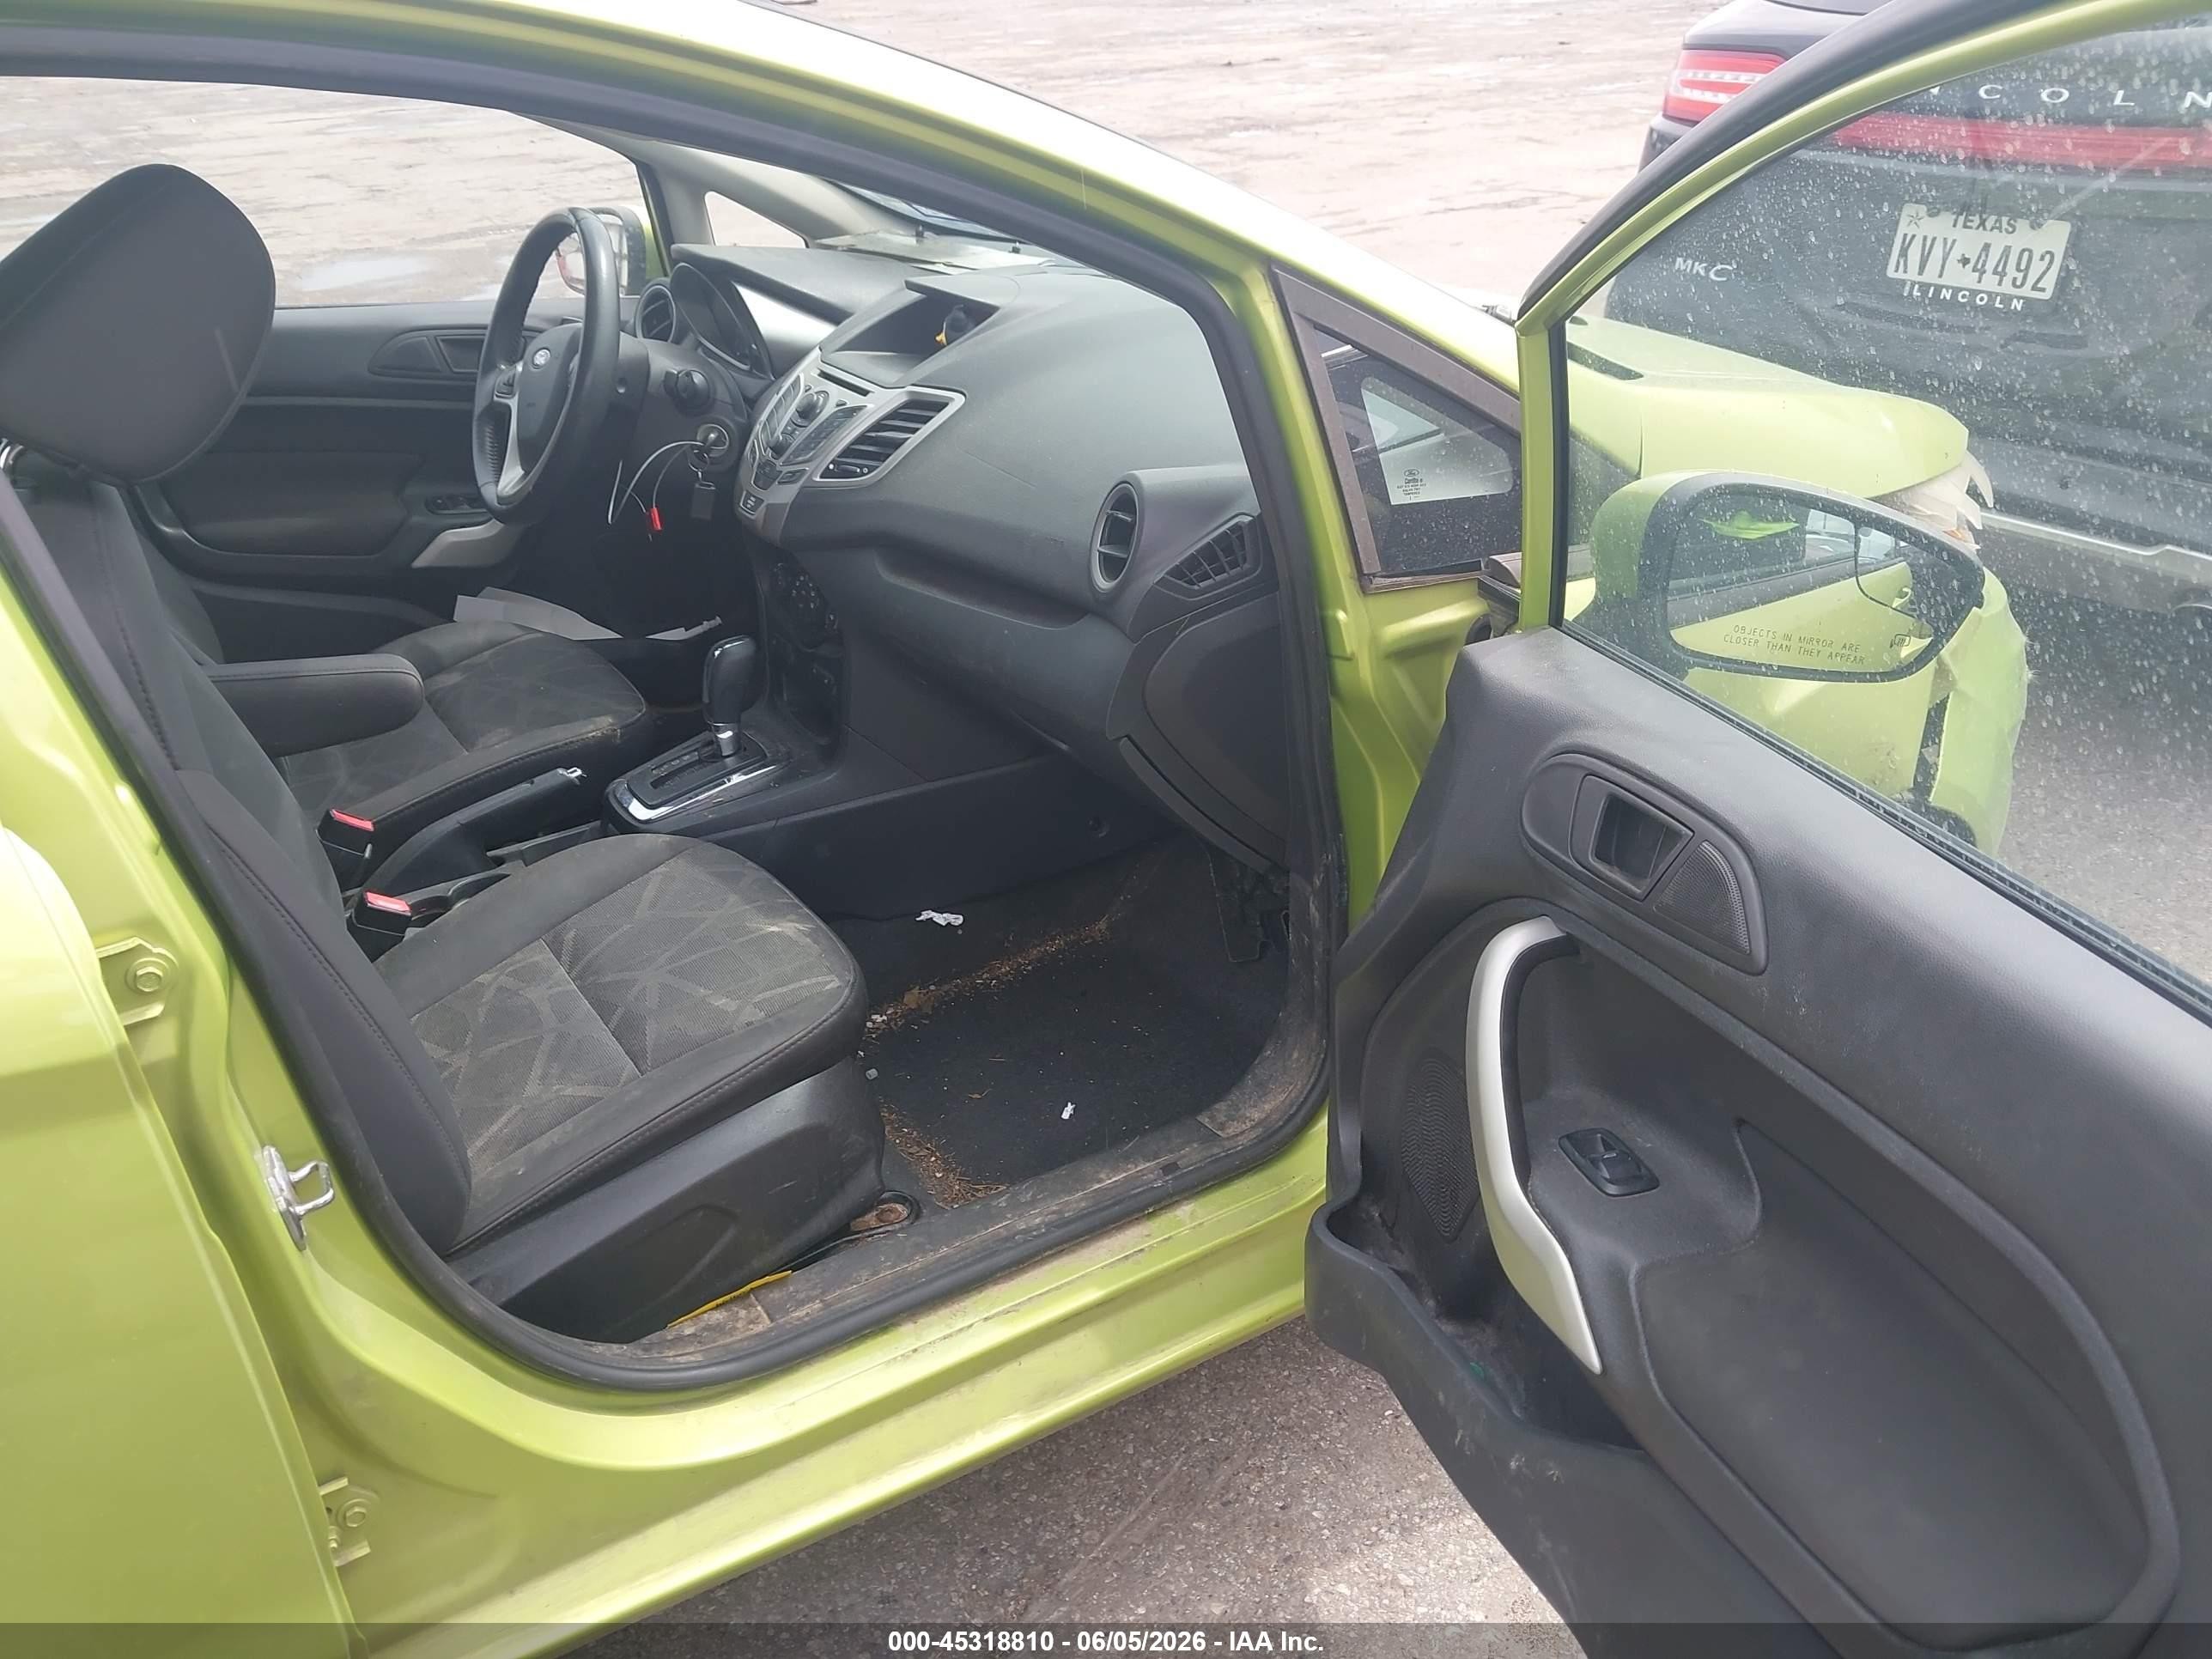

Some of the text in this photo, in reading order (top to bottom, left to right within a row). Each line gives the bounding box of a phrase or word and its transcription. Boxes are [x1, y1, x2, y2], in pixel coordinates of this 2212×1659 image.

[1952, 211, 2018, 234] TEXAS
[1675, 257, 1734, 282] MKC
[1913, 283, 2024, 311] LINCOLN
[1723, 634, 1866, 665] CLOSER THAN THEY APPEAR
[1733, 624, 1862, 653] OBJECTS IN MIRROR ARE
